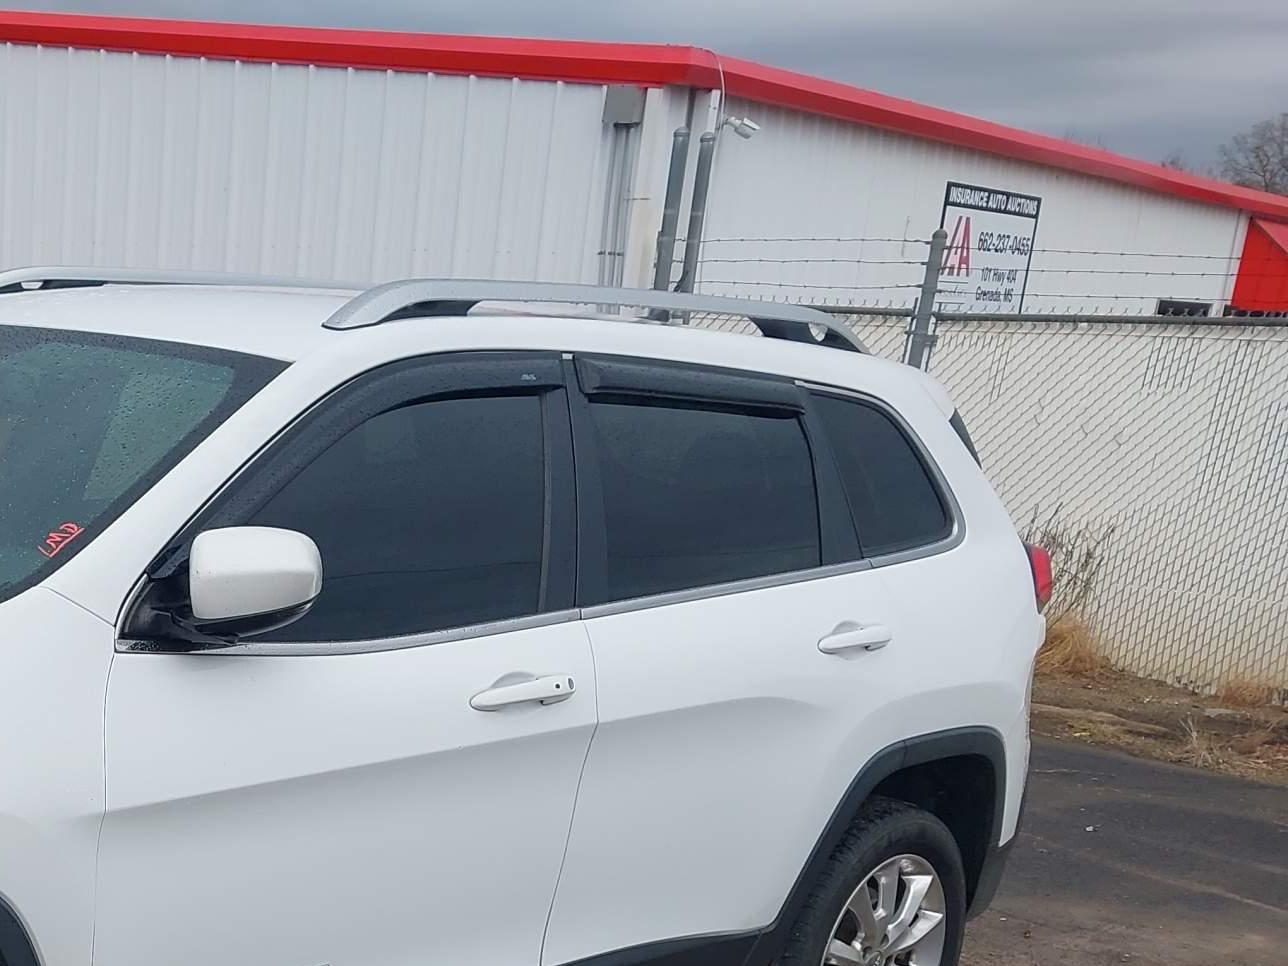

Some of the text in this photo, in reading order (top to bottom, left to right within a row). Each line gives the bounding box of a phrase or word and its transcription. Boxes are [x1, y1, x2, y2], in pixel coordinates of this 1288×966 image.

[950, 186, 1038, 216] INSURANCE AUTO AUCTIONS
[992, 268, 1007, 286] Hwy
[1003, 287, 1013, 303] MS
